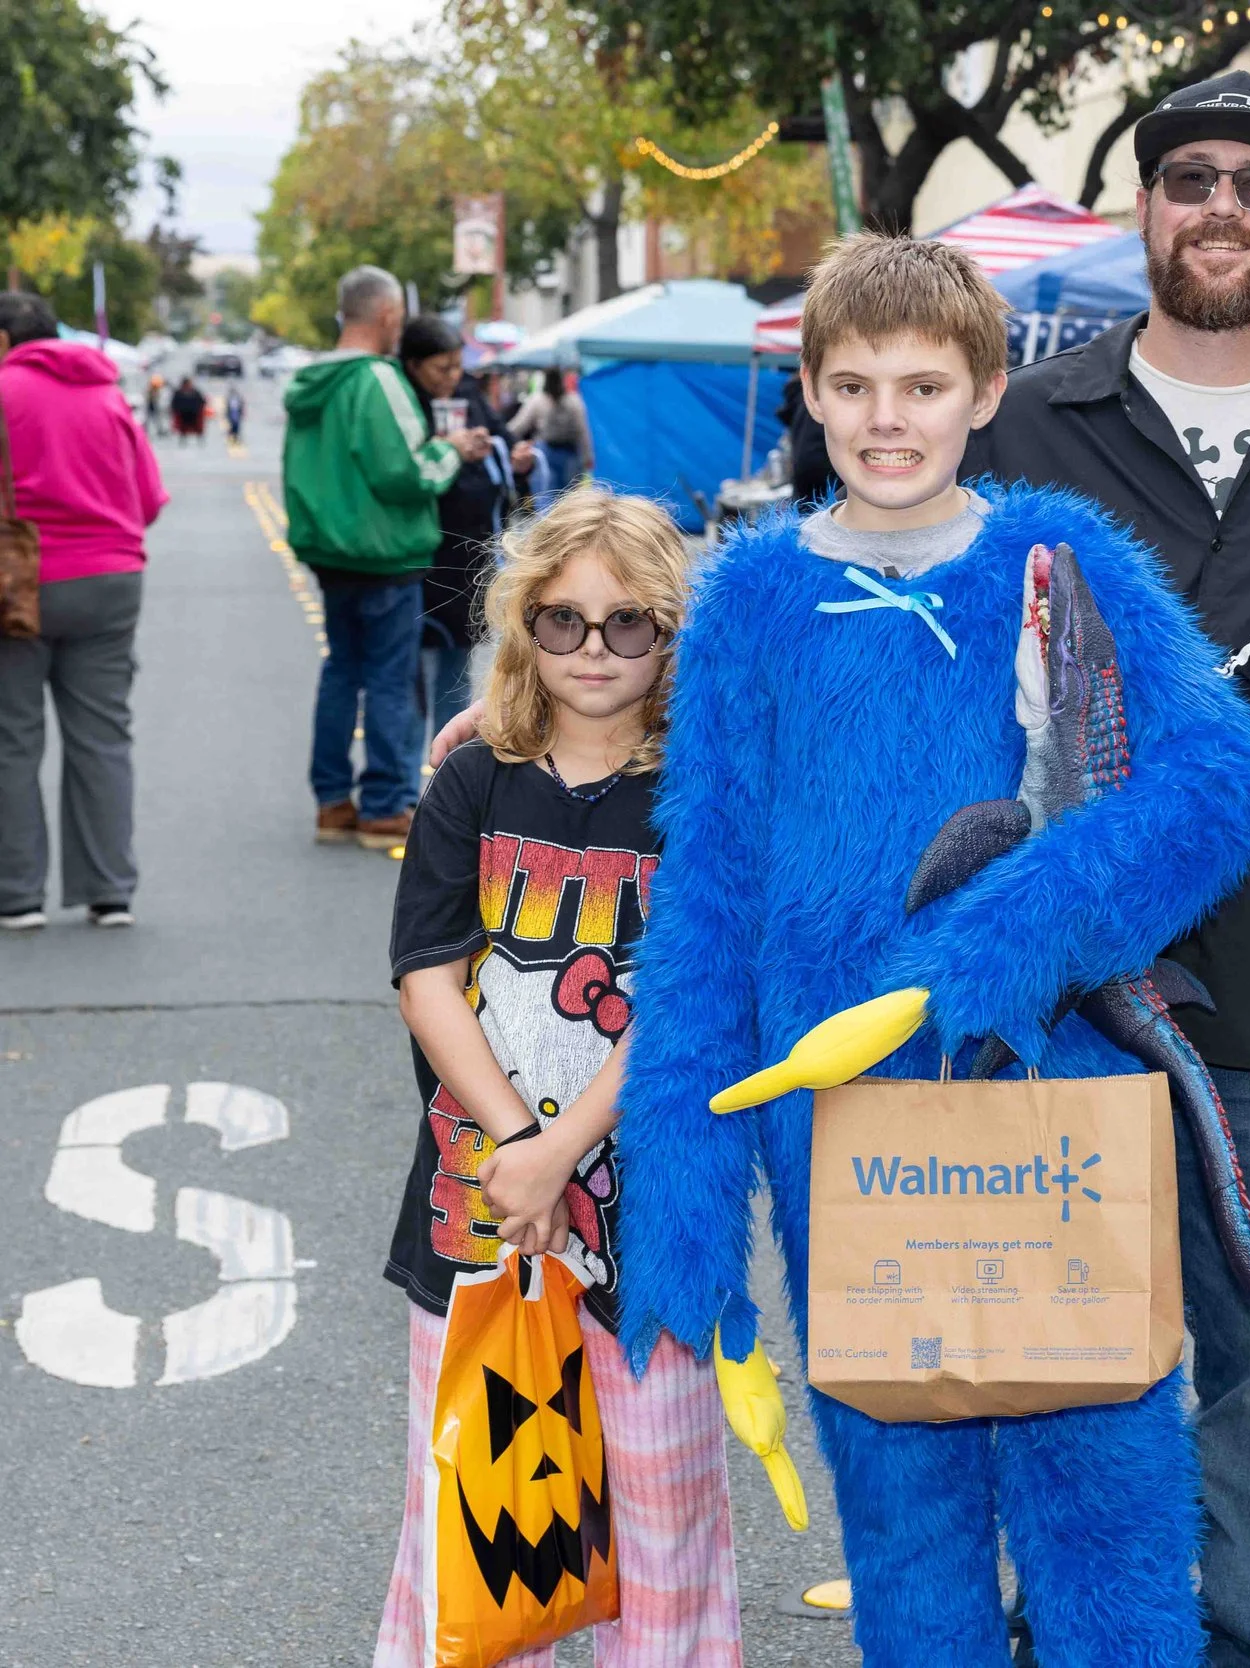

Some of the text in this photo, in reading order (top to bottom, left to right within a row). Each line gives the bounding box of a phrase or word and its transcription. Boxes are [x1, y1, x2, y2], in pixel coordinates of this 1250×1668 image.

[480, 831, 662, 948] ITT
[905, 1239, 1054, 1253] Members always get more
[846, 1286, 923, 1296] Free shipping with
[952, 1286, 1019, 1296] Video streaming
[1057, 1286, 1100, 1296] Save up to
[859, 1296, 881, 1304] order
[951, 1296, 969, 1304] with
[1065, 1298, 1080, 1306] per
[817, 1348, 889, 1358] 100% Curbside
